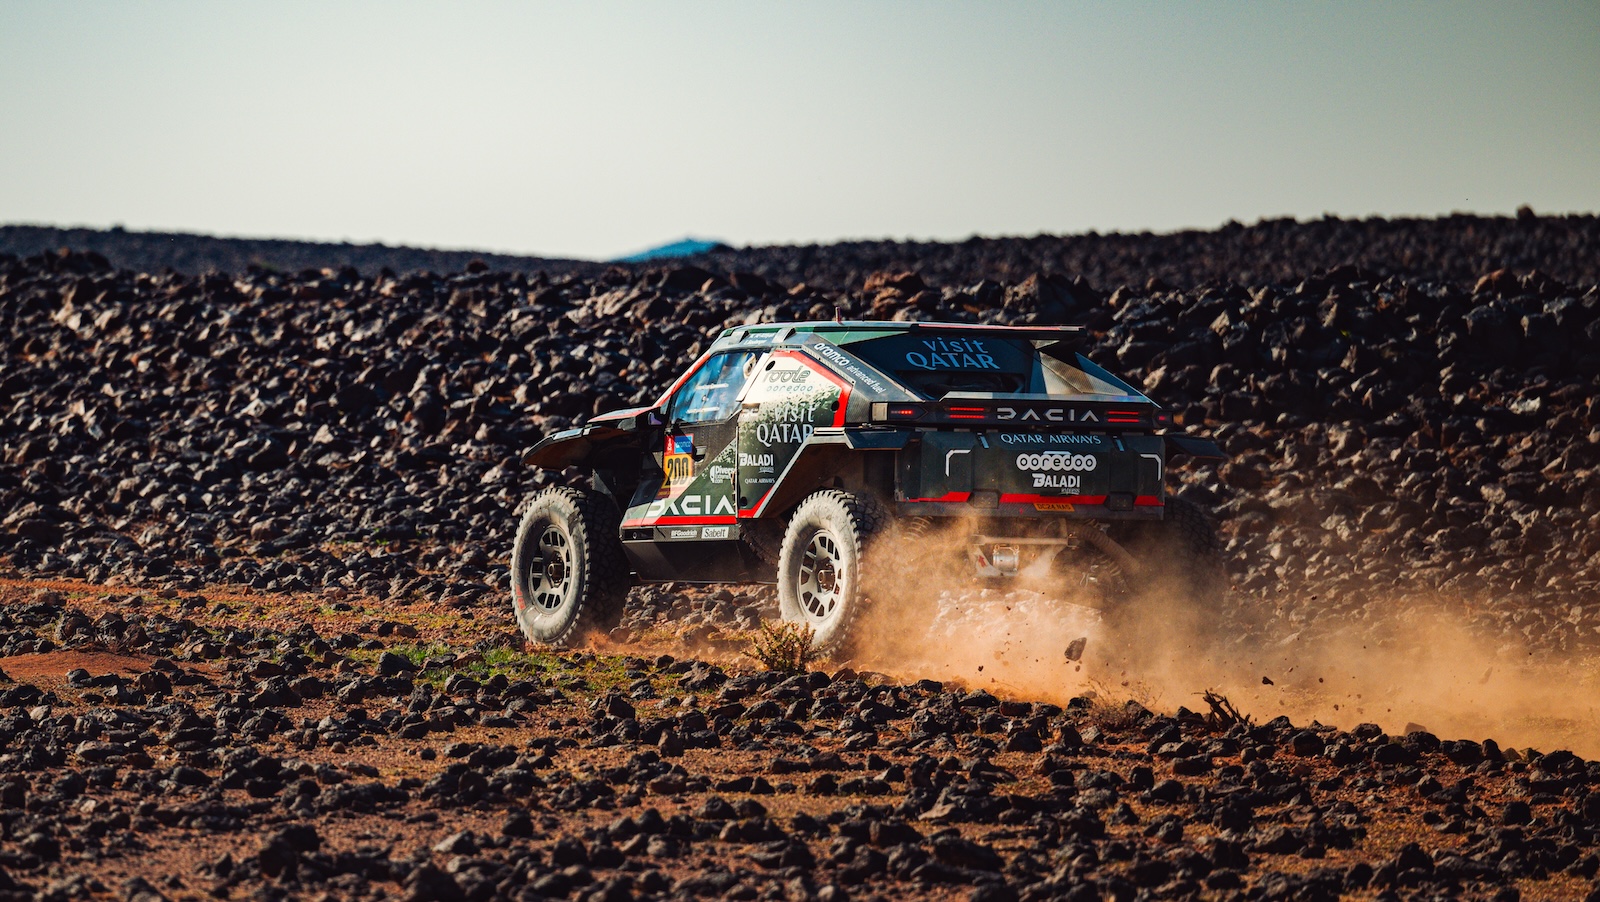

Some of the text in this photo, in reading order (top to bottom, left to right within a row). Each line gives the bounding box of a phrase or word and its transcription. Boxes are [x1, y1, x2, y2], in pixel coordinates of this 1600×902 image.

[922, 337, 988, 354] visit
[814, 343, 887, 394] aramco advanced fuel
[906, 351, 1000, 371] QATAR
[775, 402, 816, 423] visit
[997, 407, 1099, 422] DACIA
[757, 423, 814, 447] QATAR
[1001, 434, 1101, 445] QATAR AIRWAYS
[739, 453, 774, 467] BALADI
[1016, 453, 1097, 471] ooredoo
[664, 457, 688, 486] 200
[1032, 473, 1080, 488] BALADI
[646, 495, 735, 517] DACIA
[704, 528, 726, 538] Sabelt
